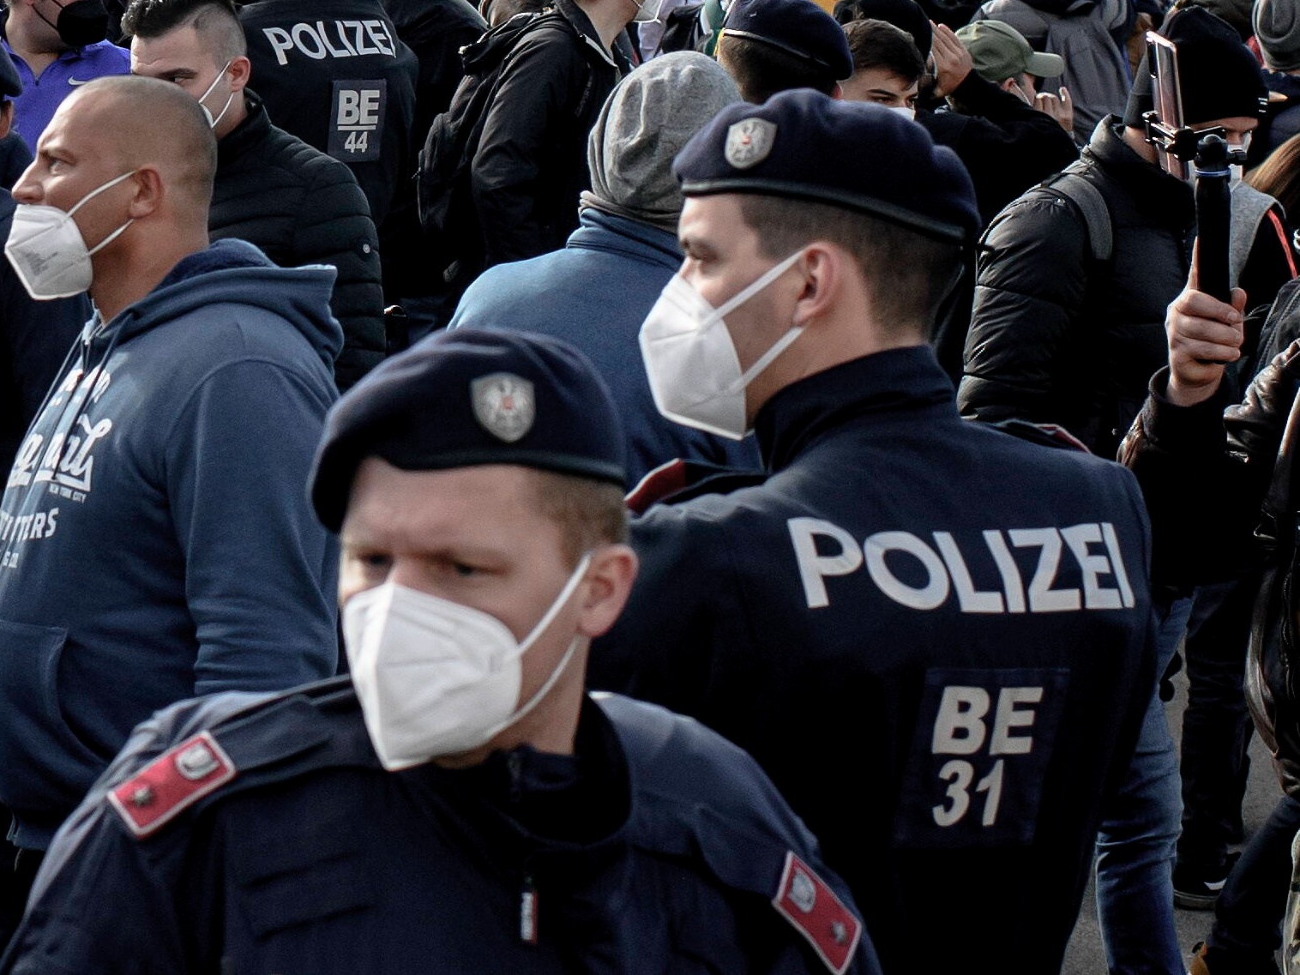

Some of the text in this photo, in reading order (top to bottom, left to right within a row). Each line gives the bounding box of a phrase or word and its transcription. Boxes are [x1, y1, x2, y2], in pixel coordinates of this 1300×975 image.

[262, 20, 397, 66] POLIZEI
[337, 89, 380, 126] BE
[344, 131, 368, 153] 44
[787, 517, 1136, 614] POLIZEI
[932, 685, 1044, 756] BE
[932, 759, 1005, 827] 31
